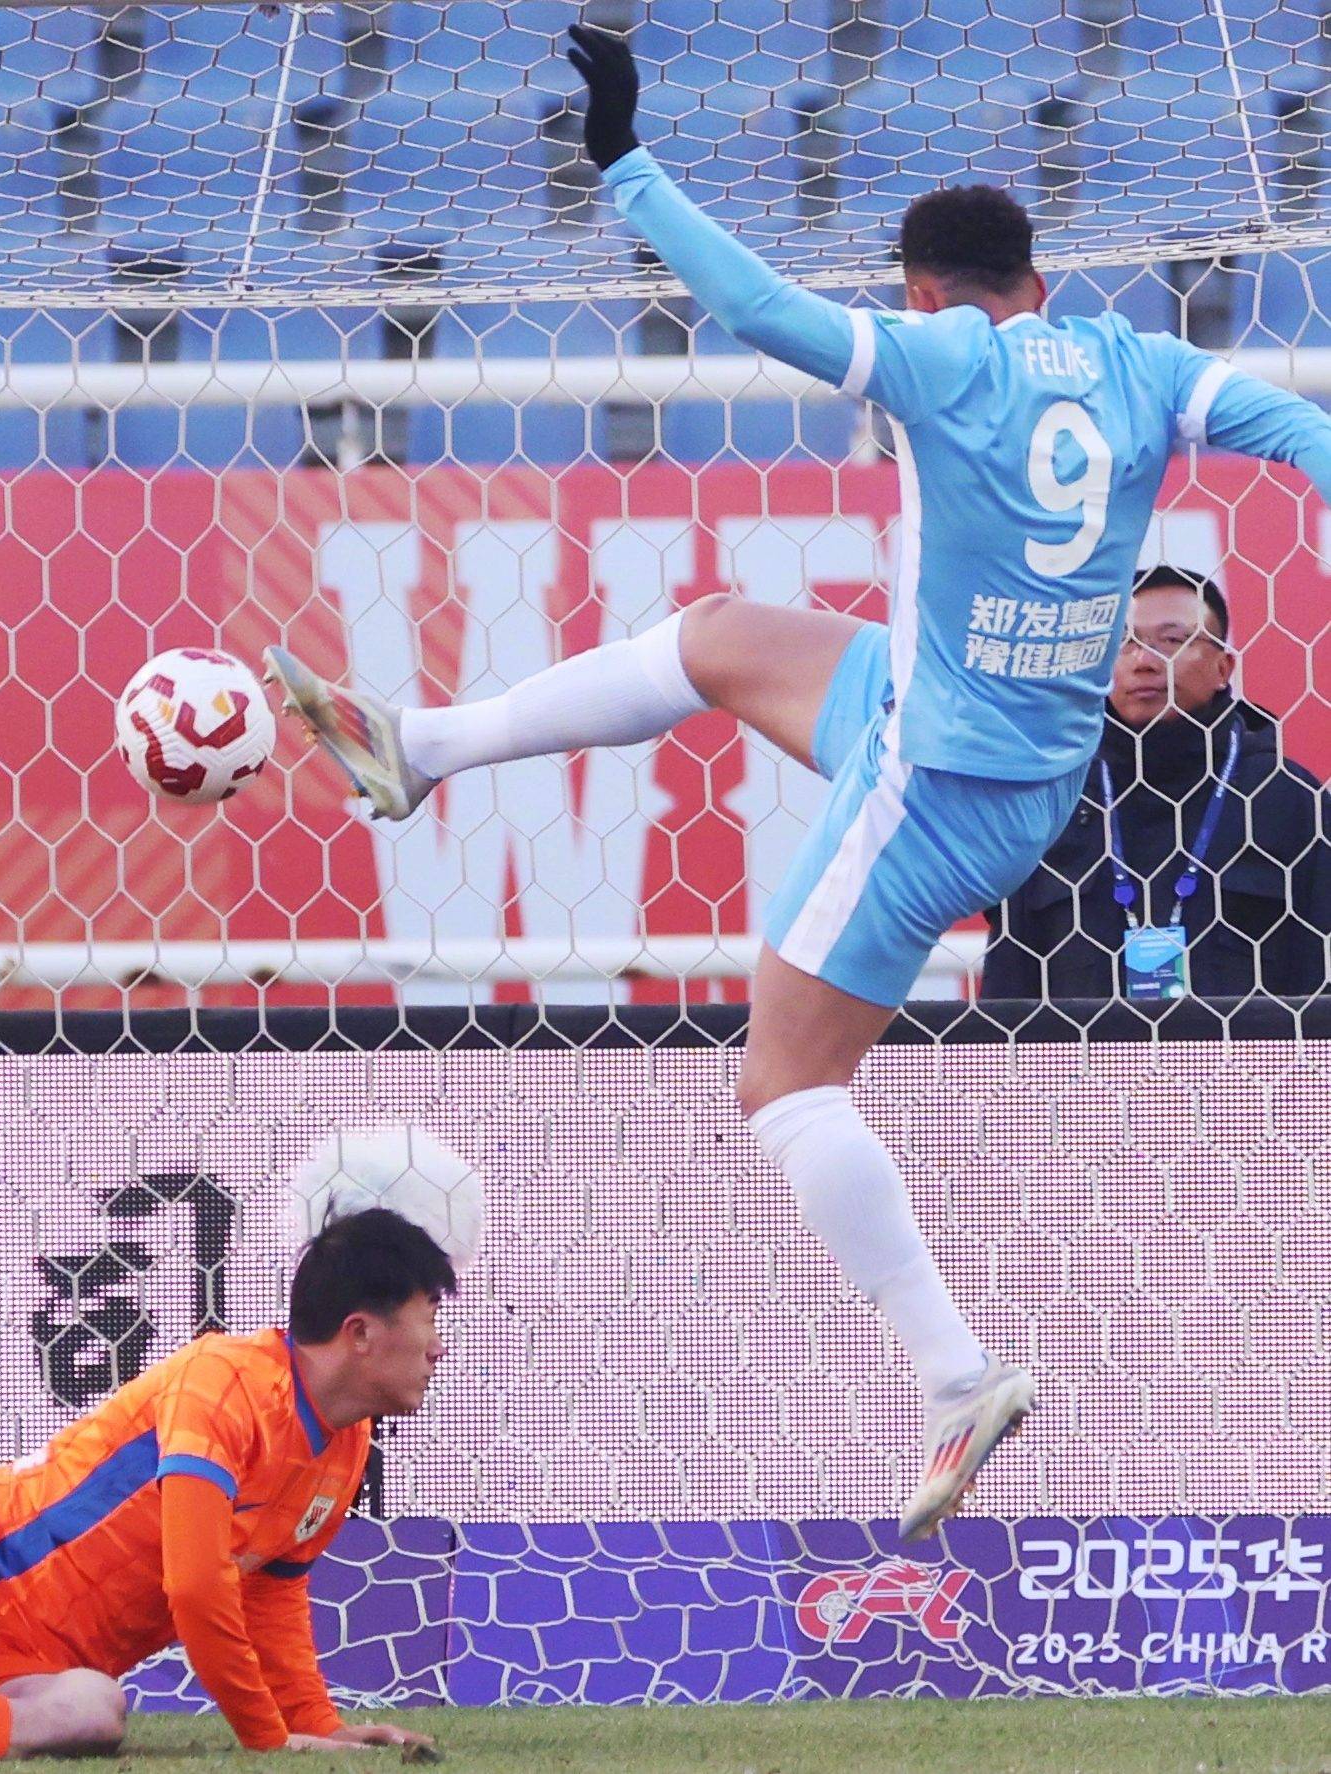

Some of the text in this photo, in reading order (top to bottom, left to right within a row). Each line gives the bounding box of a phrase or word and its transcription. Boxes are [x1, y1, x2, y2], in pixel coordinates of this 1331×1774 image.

[1024, 400, 1113, 578] 9
[969, 593, 1121, 639] 郑发集团
[963, 633, 1112, 680] 豫健集团
[1015, 1633, 1121, 1665] 2025
[1141, 1632, 1281, 1664] CHINA
